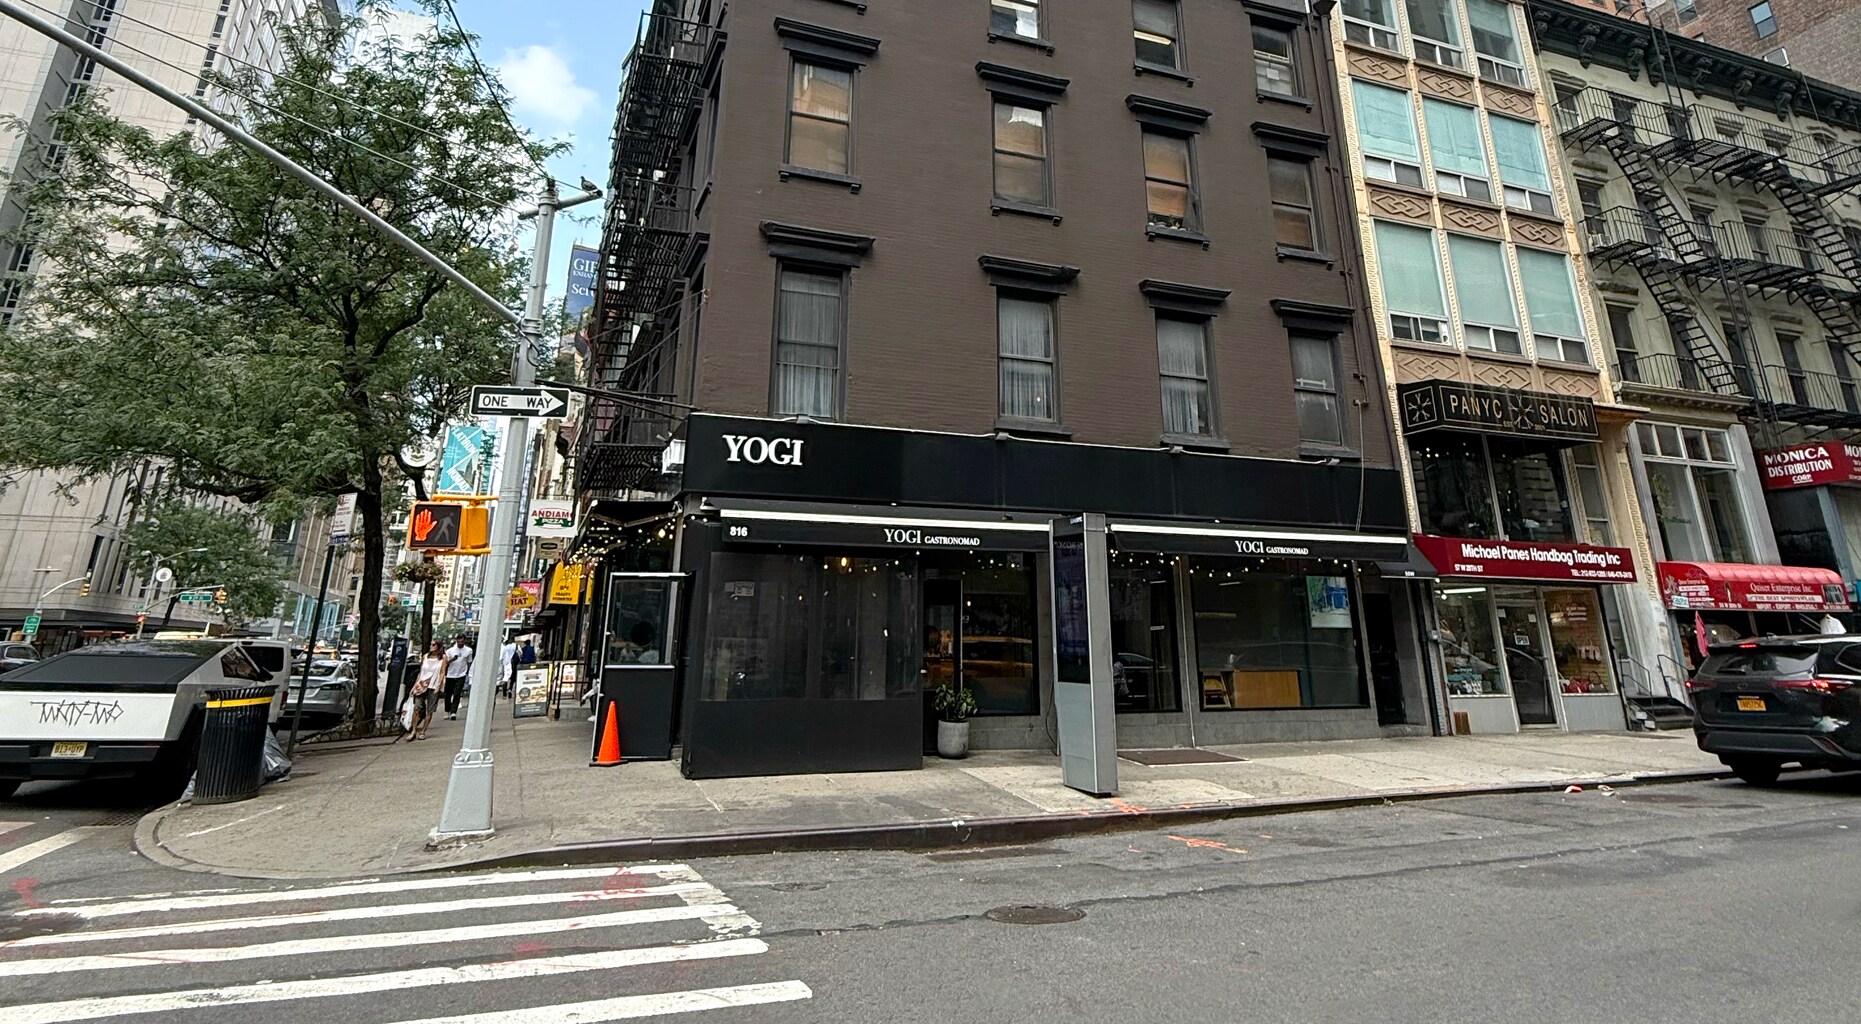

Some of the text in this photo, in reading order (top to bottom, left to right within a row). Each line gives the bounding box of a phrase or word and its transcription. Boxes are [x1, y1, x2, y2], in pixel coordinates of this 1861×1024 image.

[482, 395, 553, 409] ONE WAY
[1450, 394, 1589, 426] PANYC SALON
[722, 434, 804, 466] YOGI
[1764, 444, 1830, 465] MONICA
[1767, 459, 1834, 478] DISTRIBUTION
[729, 526, 748, 537] 816
[883, 528, 980, 546] YOGI GASTRONOMAD
[1234, 540, 1309, 555] YOGI GASTRONOMAD
[1461, 543, 1621, 567] Michael Panes Handbag Trading Inc
[1771, 583, 1802, 595] Enterprise
